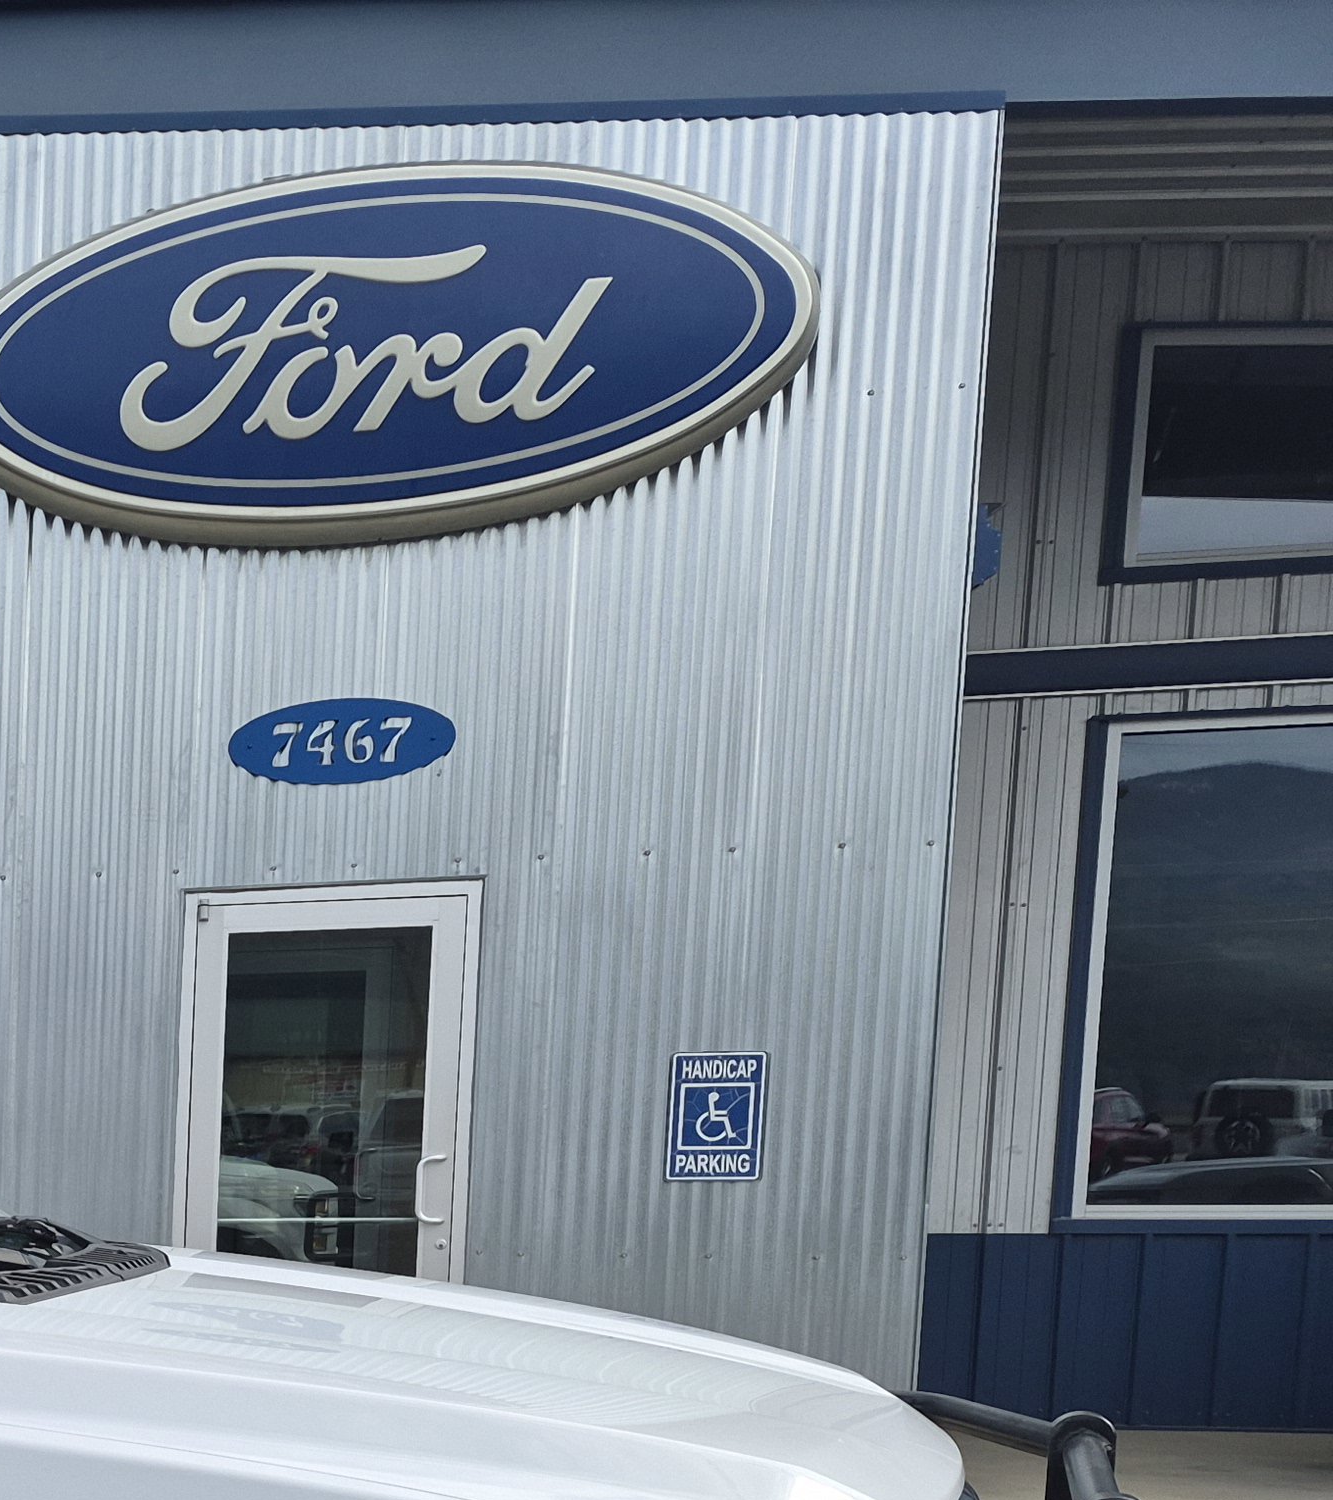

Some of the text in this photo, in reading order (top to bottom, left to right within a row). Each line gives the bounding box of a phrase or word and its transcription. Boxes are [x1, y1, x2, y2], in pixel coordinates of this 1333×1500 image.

[119, 244, 614, 452] Ford
[271, 716, 413, 768] 7467
[681, 1058, 758, 1080] HANDICAP
[673, 1152, 751, 1175] PARKING
